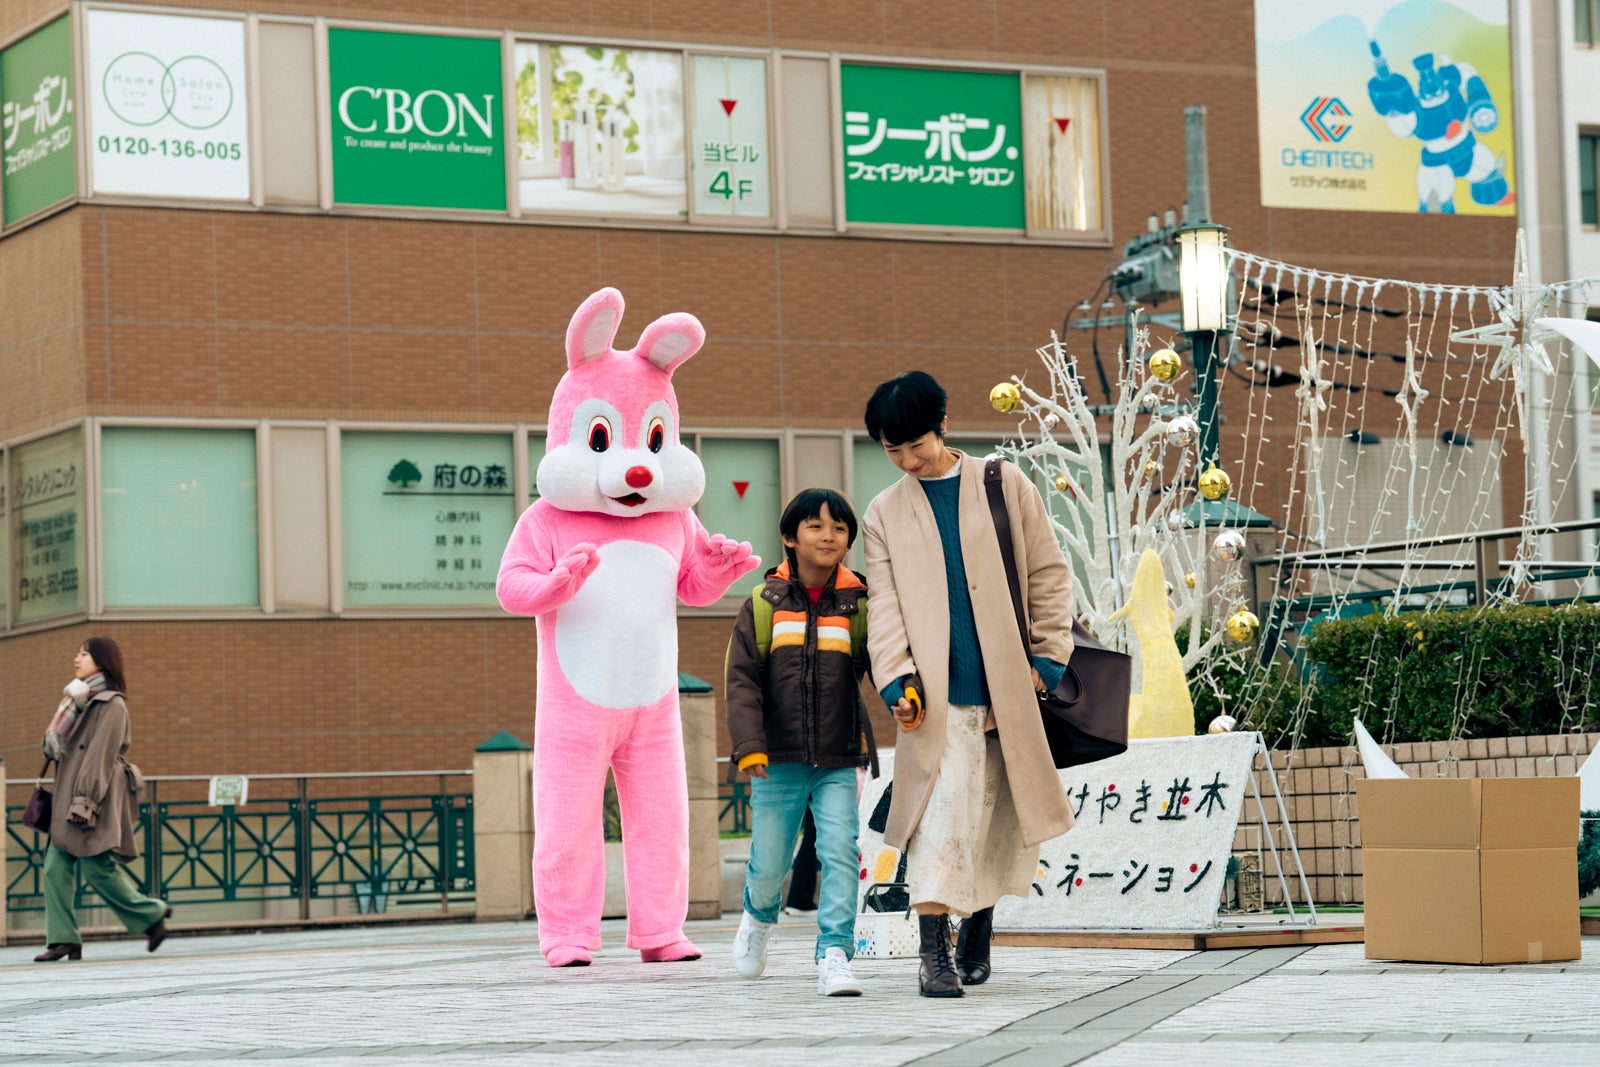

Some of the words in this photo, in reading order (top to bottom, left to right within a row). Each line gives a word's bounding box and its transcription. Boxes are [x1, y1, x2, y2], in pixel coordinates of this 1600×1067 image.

[338, 85, 495, 139] C'BON
[98, 135, 242, 161] 0120-136-005
[344, 135, 358, 147] To
[360, 139, 388, 149] create
[389, 138, 407, 150] and
[408, 139, 444, 153] produce
[446, 141, 461, 152] the
[703, 142, 759, 163] 当ビル
[709, 170, 753, 200] 4F
[434, 463, 507, 489] 府の森
